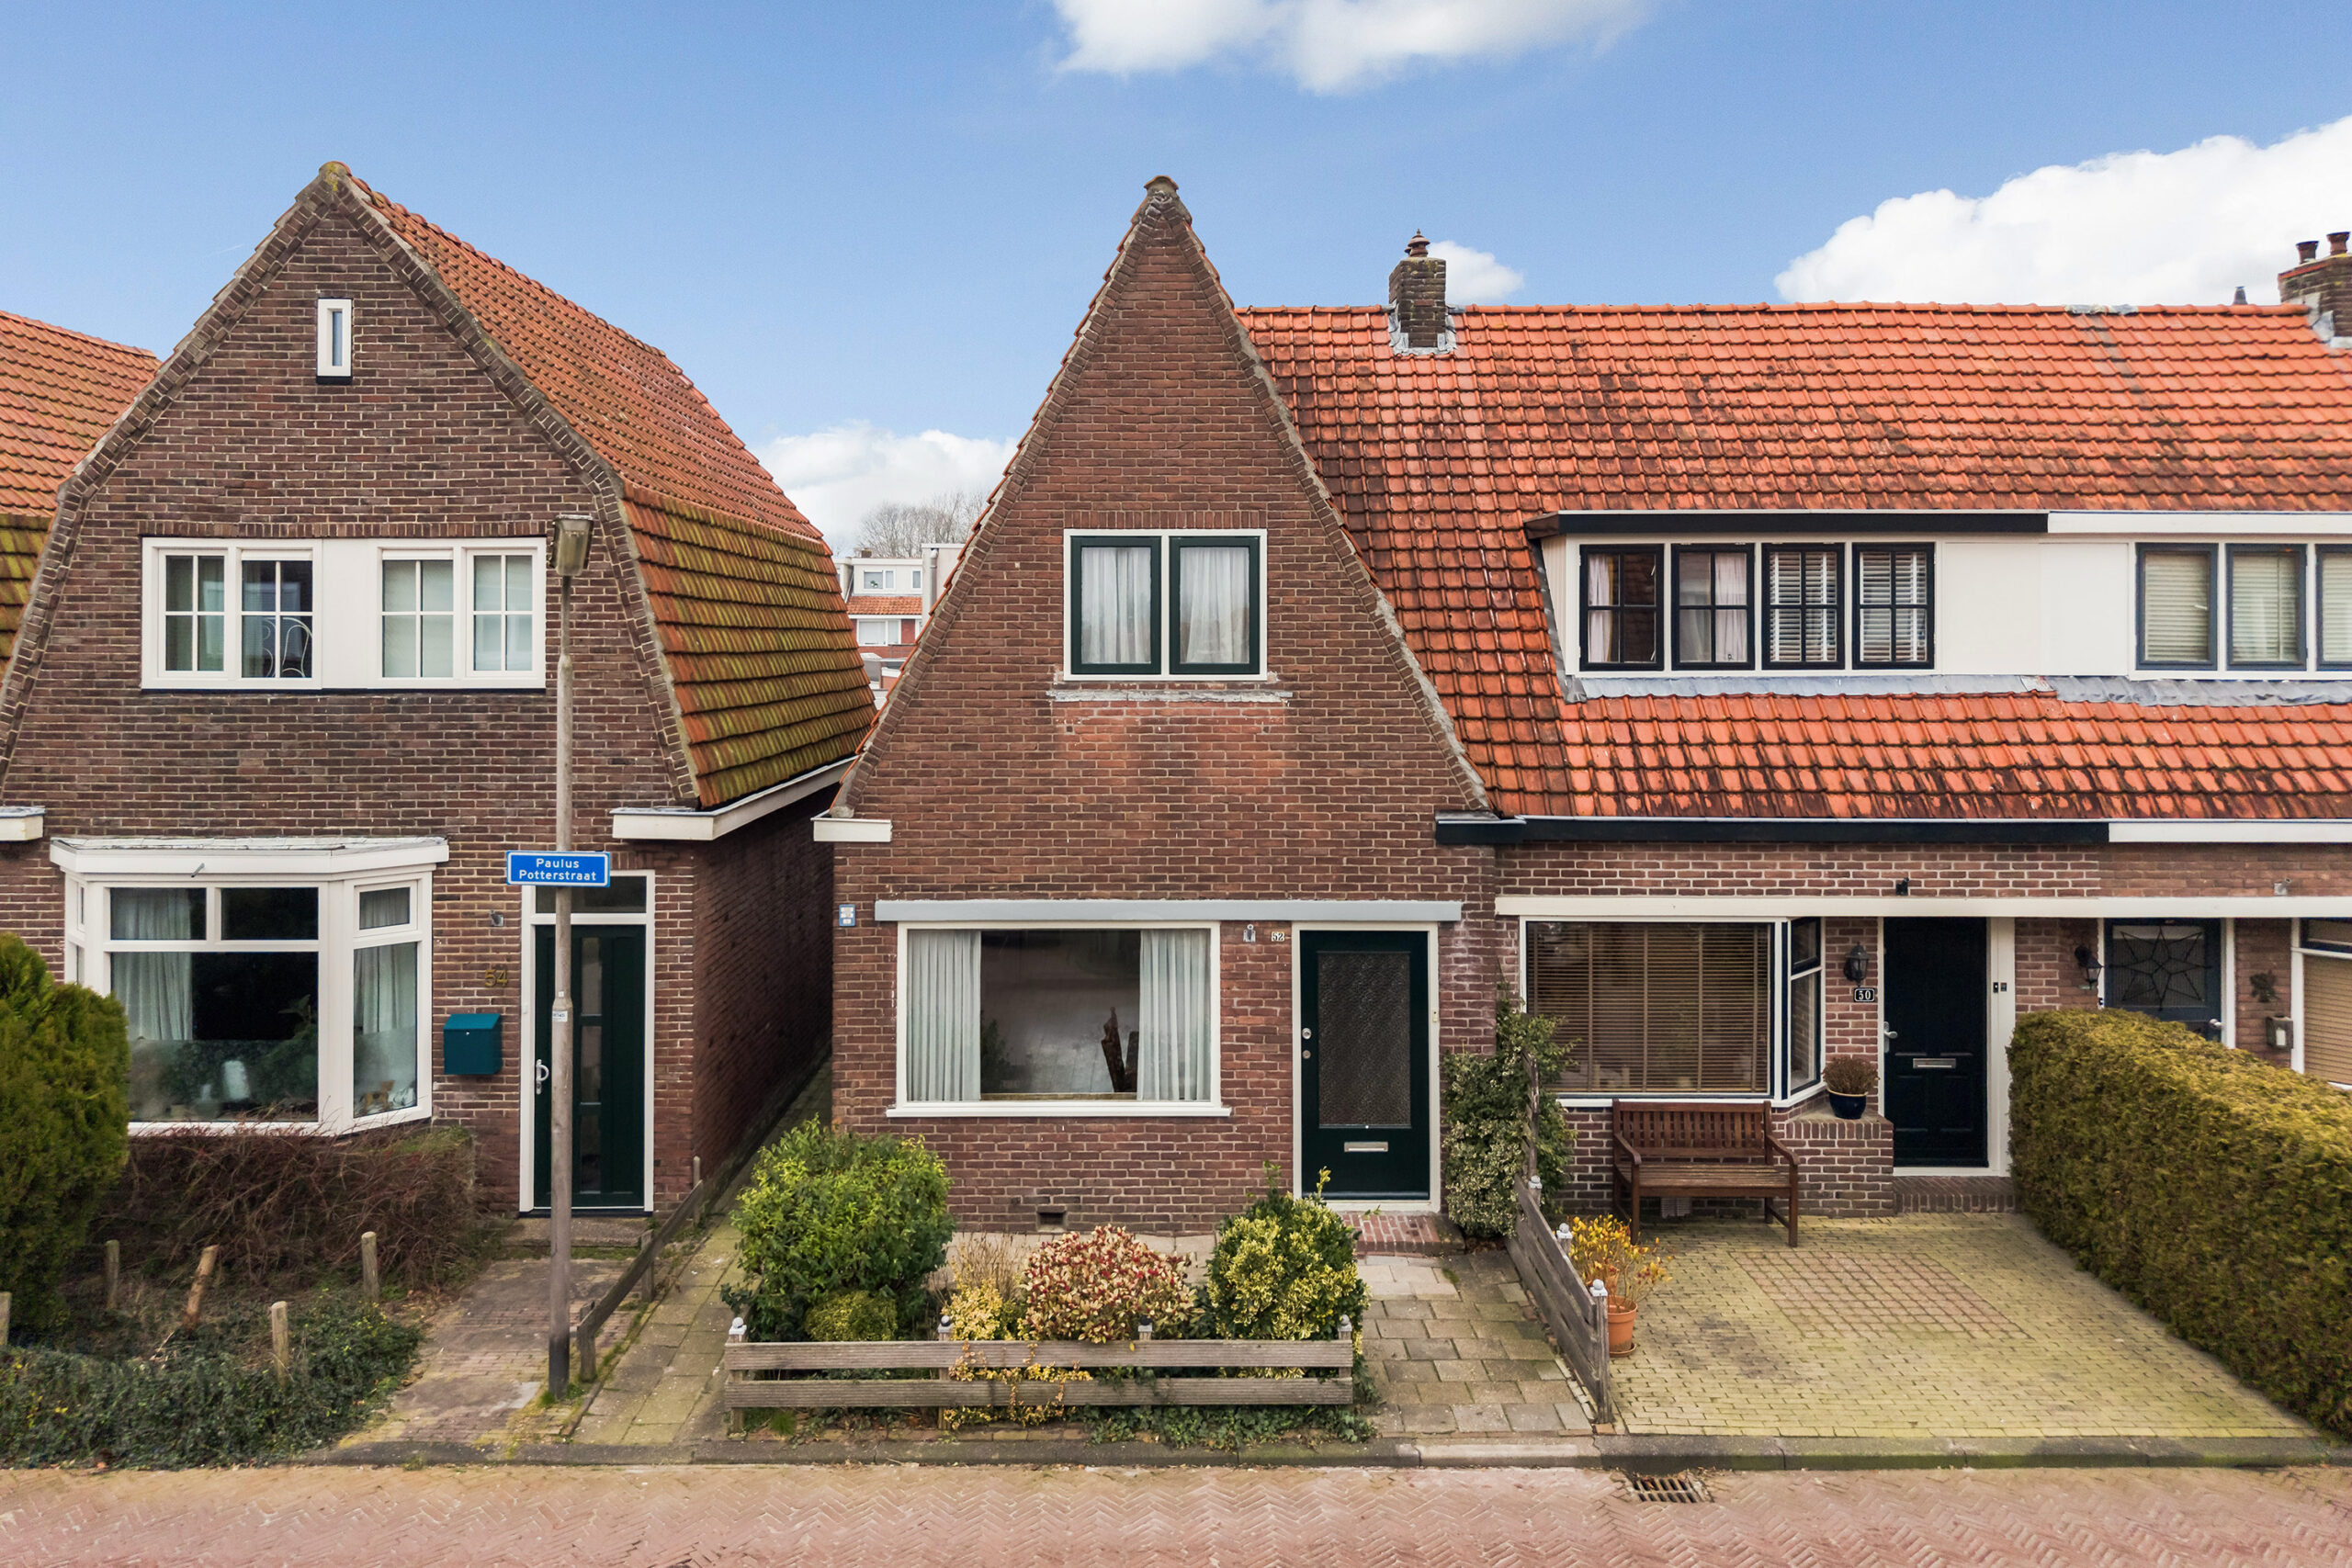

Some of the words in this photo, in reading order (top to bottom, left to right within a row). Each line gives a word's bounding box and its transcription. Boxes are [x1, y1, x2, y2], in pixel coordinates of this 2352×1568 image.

[536, 858, 580, 868] Paulus
[519, 869, 596, 881] Potterstraat
[1272, 932, 1283, 941] 52
[485, 969, 507, 987] 54
[1859, 990, 1871, 1000] 50
